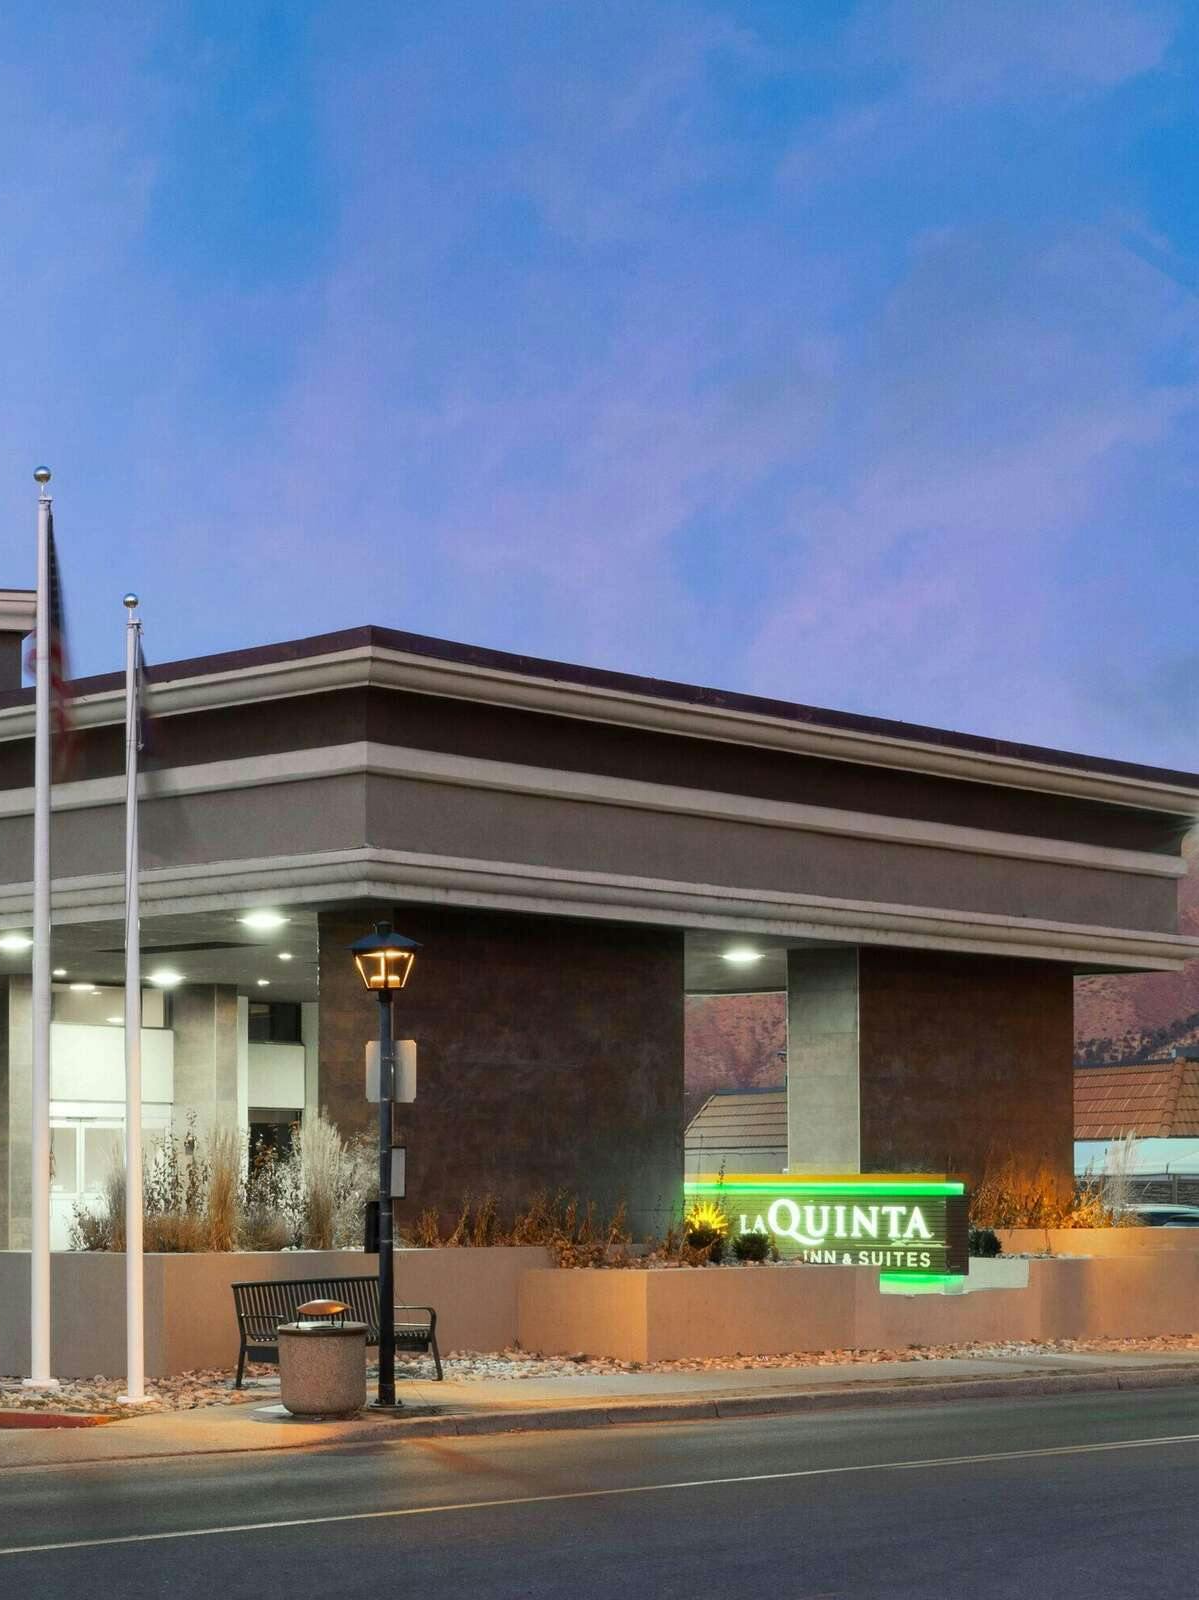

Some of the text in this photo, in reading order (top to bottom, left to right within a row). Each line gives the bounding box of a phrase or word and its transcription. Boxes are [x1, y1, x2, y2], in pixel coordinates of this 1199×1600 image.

[739, 1198, 933, 1245] LA QUINTA
[803, 1250, 931, 1267] INN & SUITES
